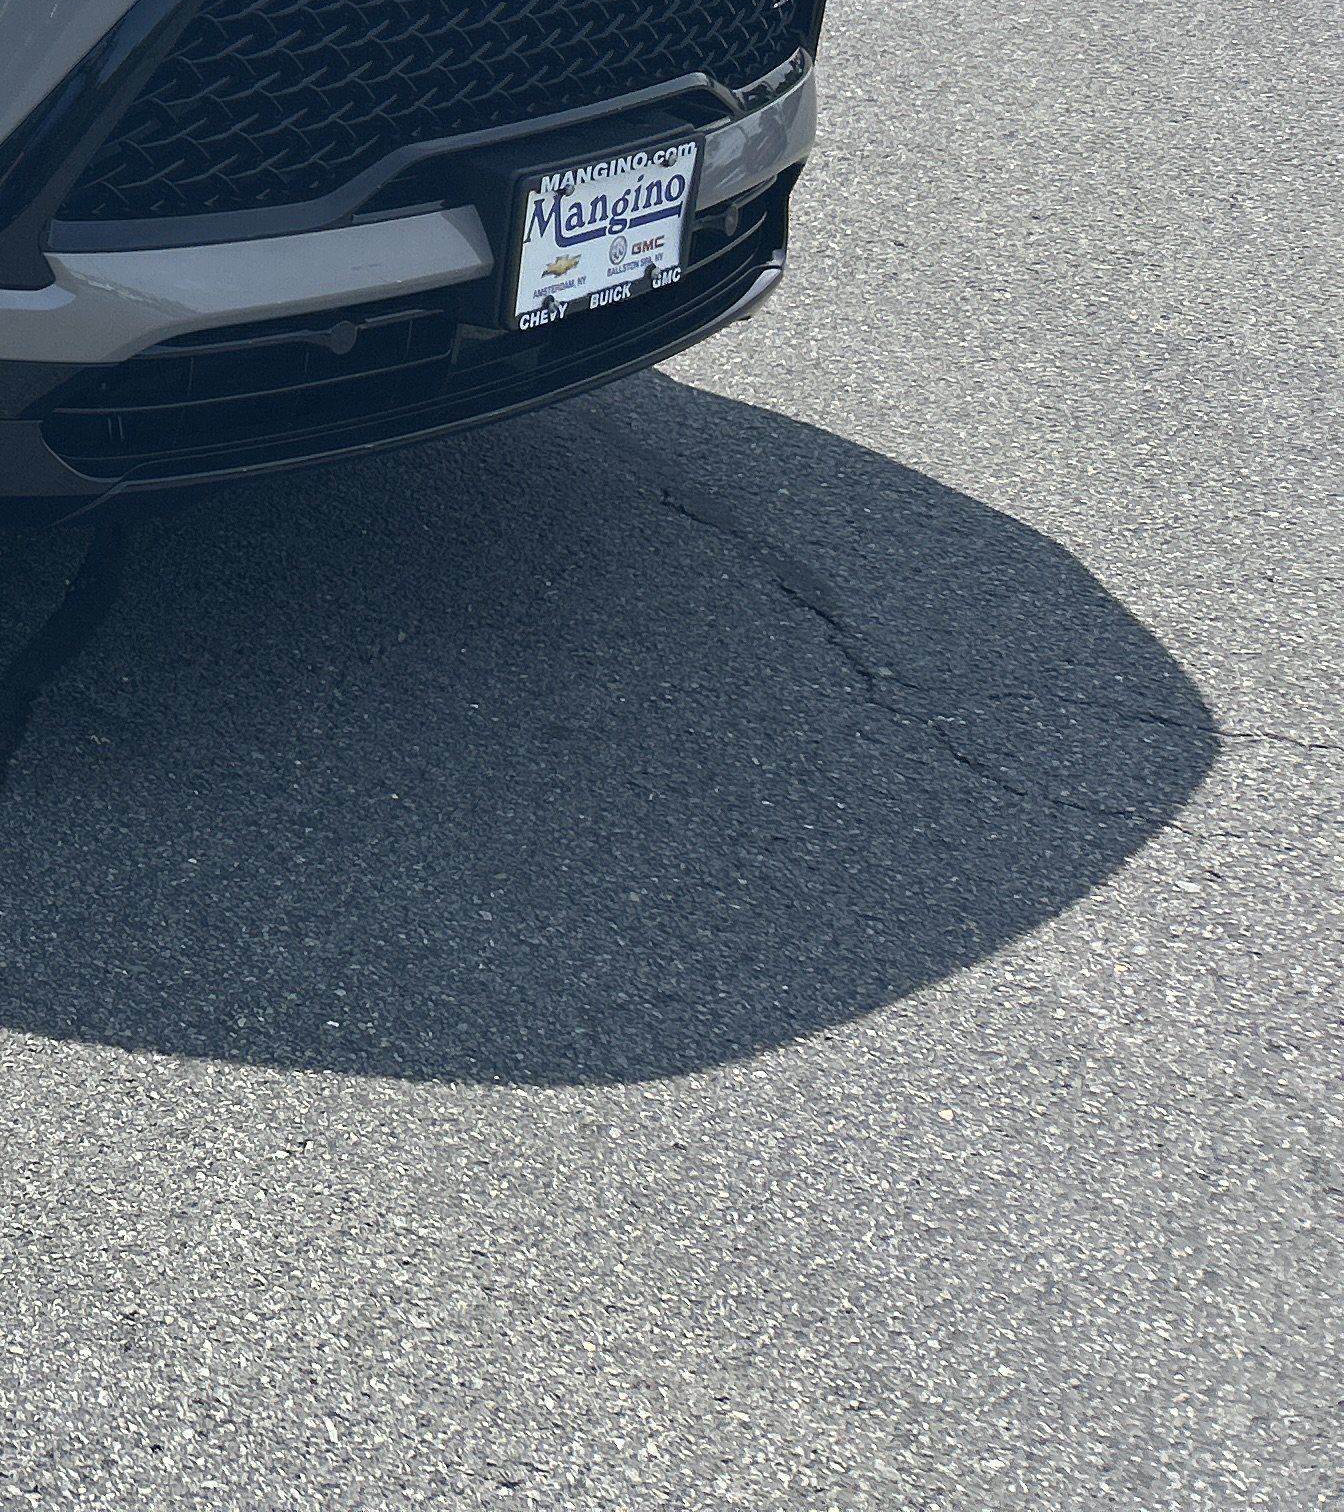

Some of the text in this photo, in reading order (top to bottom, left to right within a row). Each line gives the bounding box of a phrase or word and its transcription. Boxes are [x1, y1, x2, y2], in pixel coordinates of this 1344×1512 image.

[540, 140, 697, 194] MANGINO.com
[523, 174, 686, 246] Mangino
[631, 235, 665, 255] GMC
[589, 283, 632, 310] BUICK
[652, 267, 682, 289] GMC
[606, 260, 639, 278] BALLSTON
